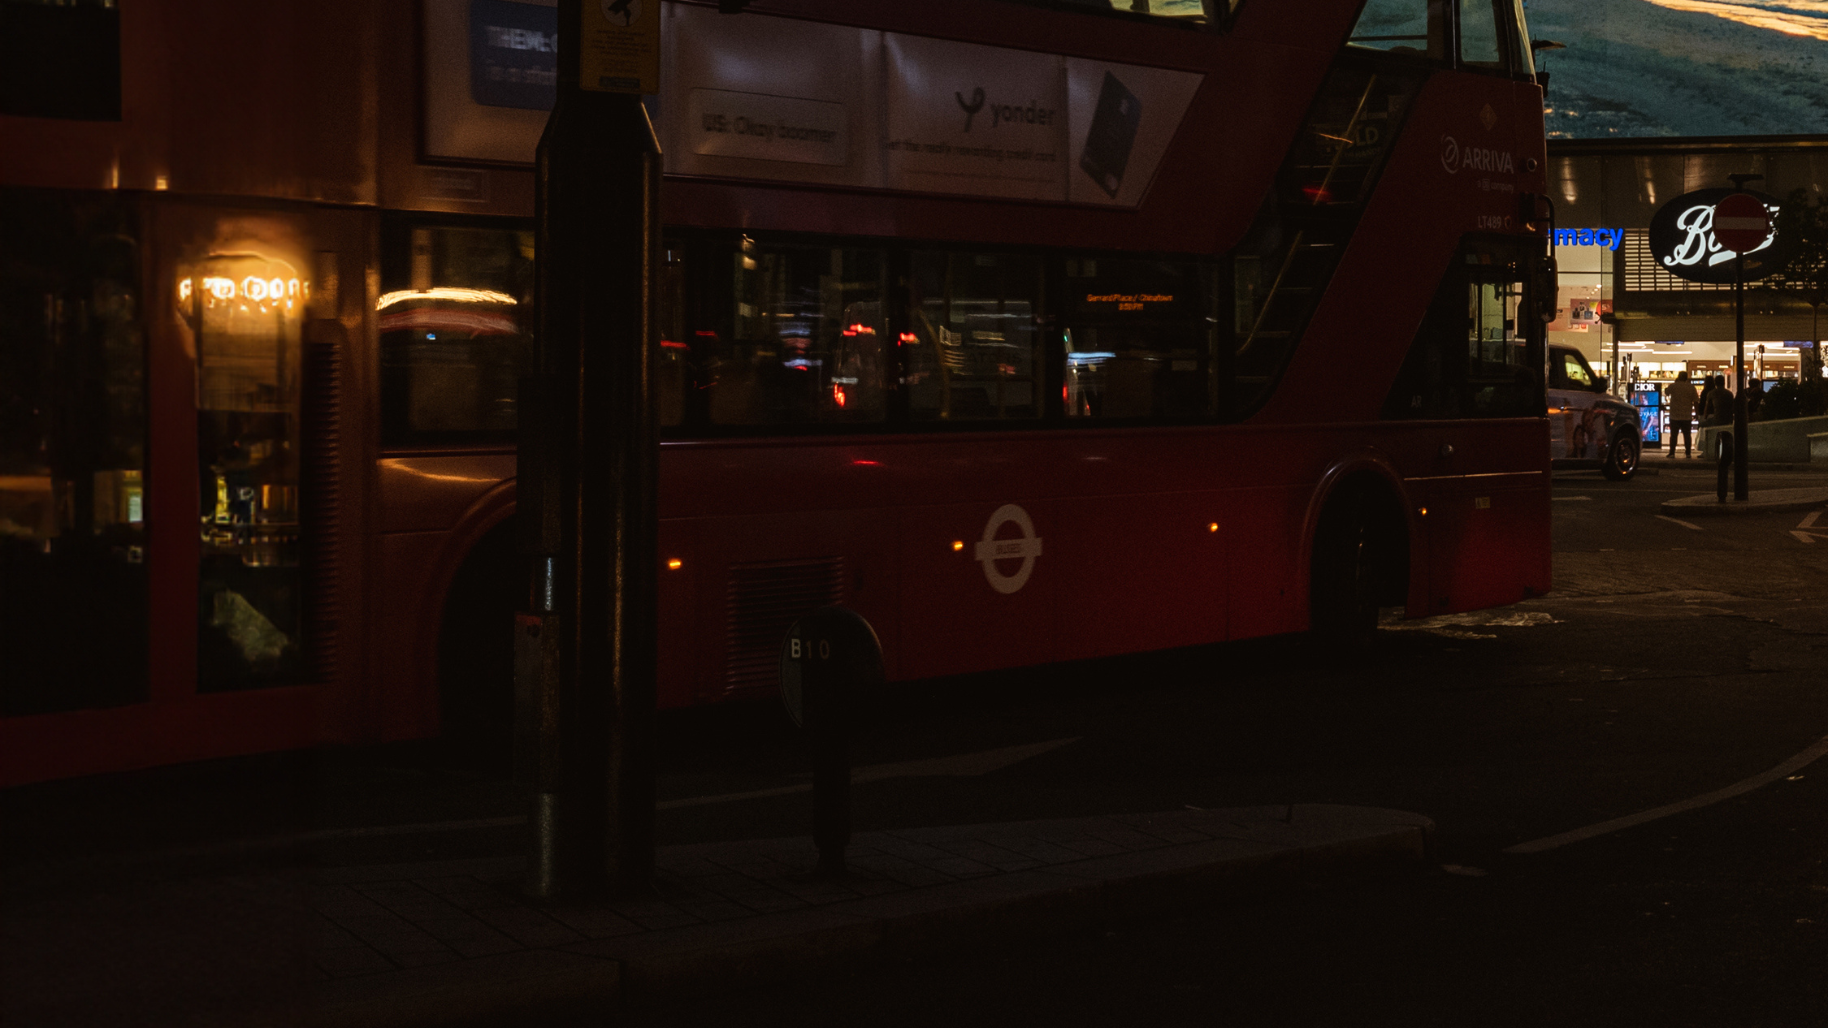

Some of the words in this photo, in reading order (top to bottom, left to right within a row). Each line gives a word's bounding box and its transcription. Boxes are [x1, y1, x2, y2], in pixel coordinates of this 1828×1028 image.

[990, 99, 1056, 128] yonder
[1462, 146, 1514, 175] ARRIVA
[1634, 383, 1656, 392] DIOR
[1411, 394, 1422, 409] AR
[791, 639, 831, 659] B10
